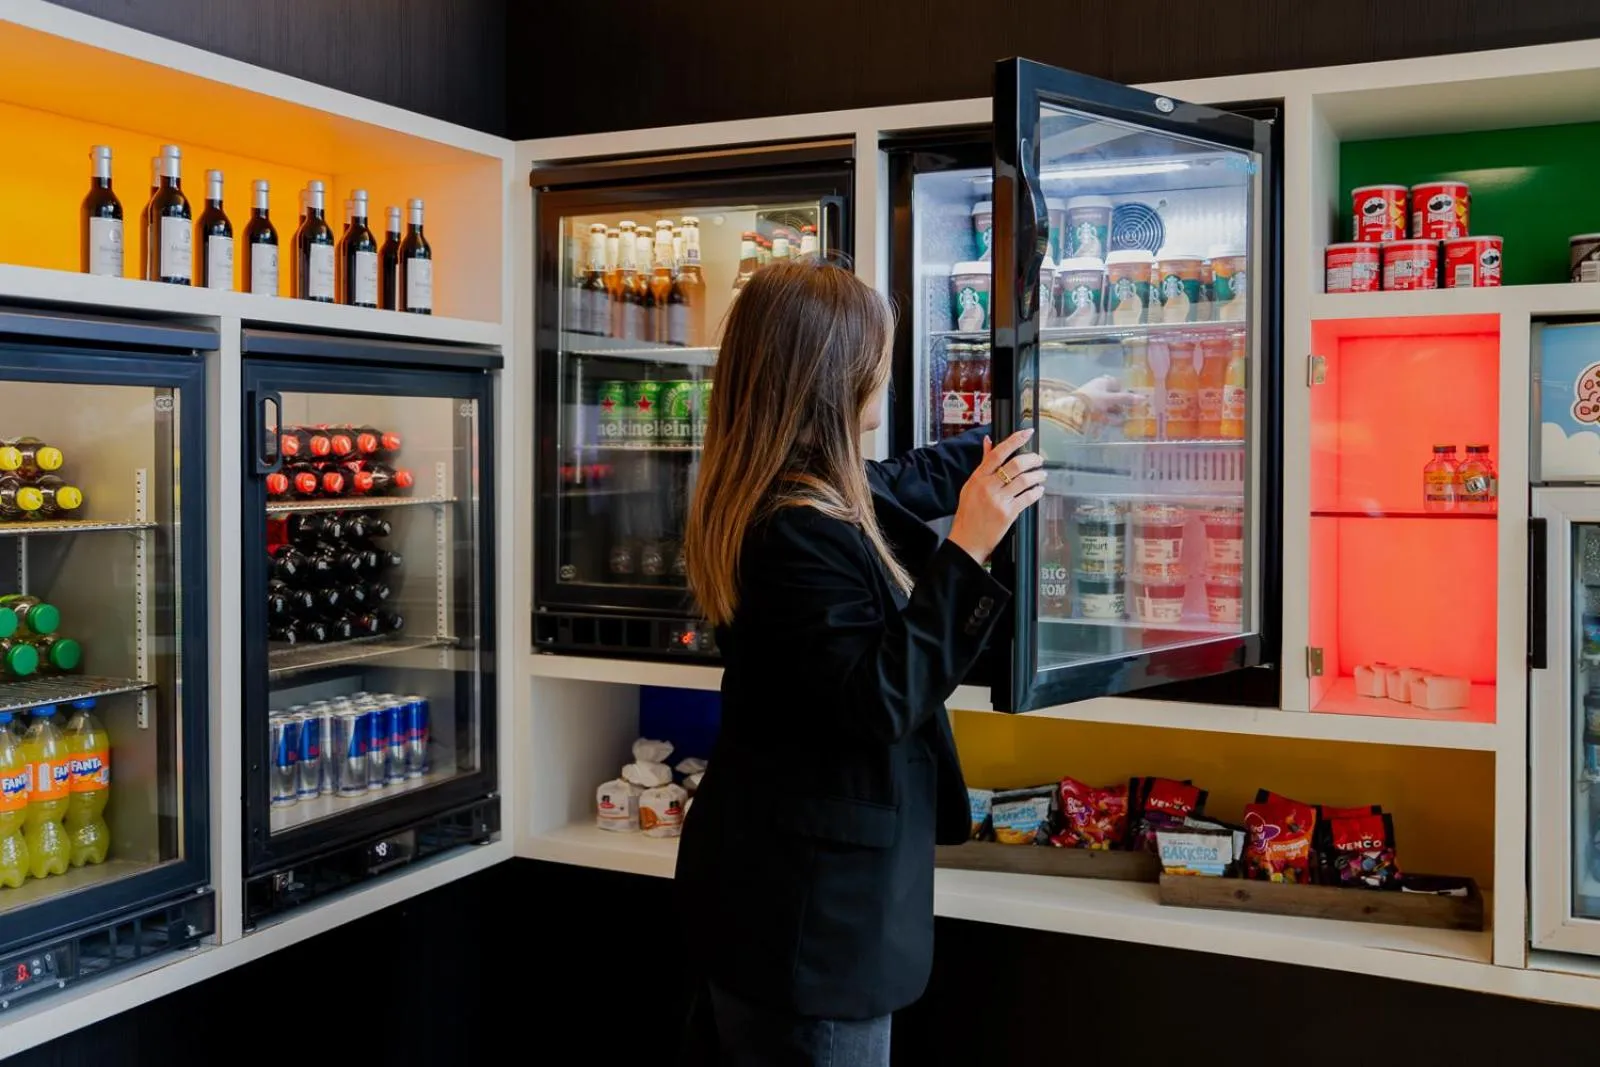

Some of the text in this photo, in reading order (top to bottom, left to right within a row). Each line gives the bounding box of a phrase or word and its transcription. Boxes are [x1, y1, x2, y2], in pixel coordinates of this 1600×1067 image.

[1041, 568, 1066, 581] BIG
[1041, 584, 1066, 597] TOM
[1149, 797, 1192, 812] VENCO
[1336, 839, 1383, 851] VENCO
[1162, 845, 1218, 861] BAKKERS
